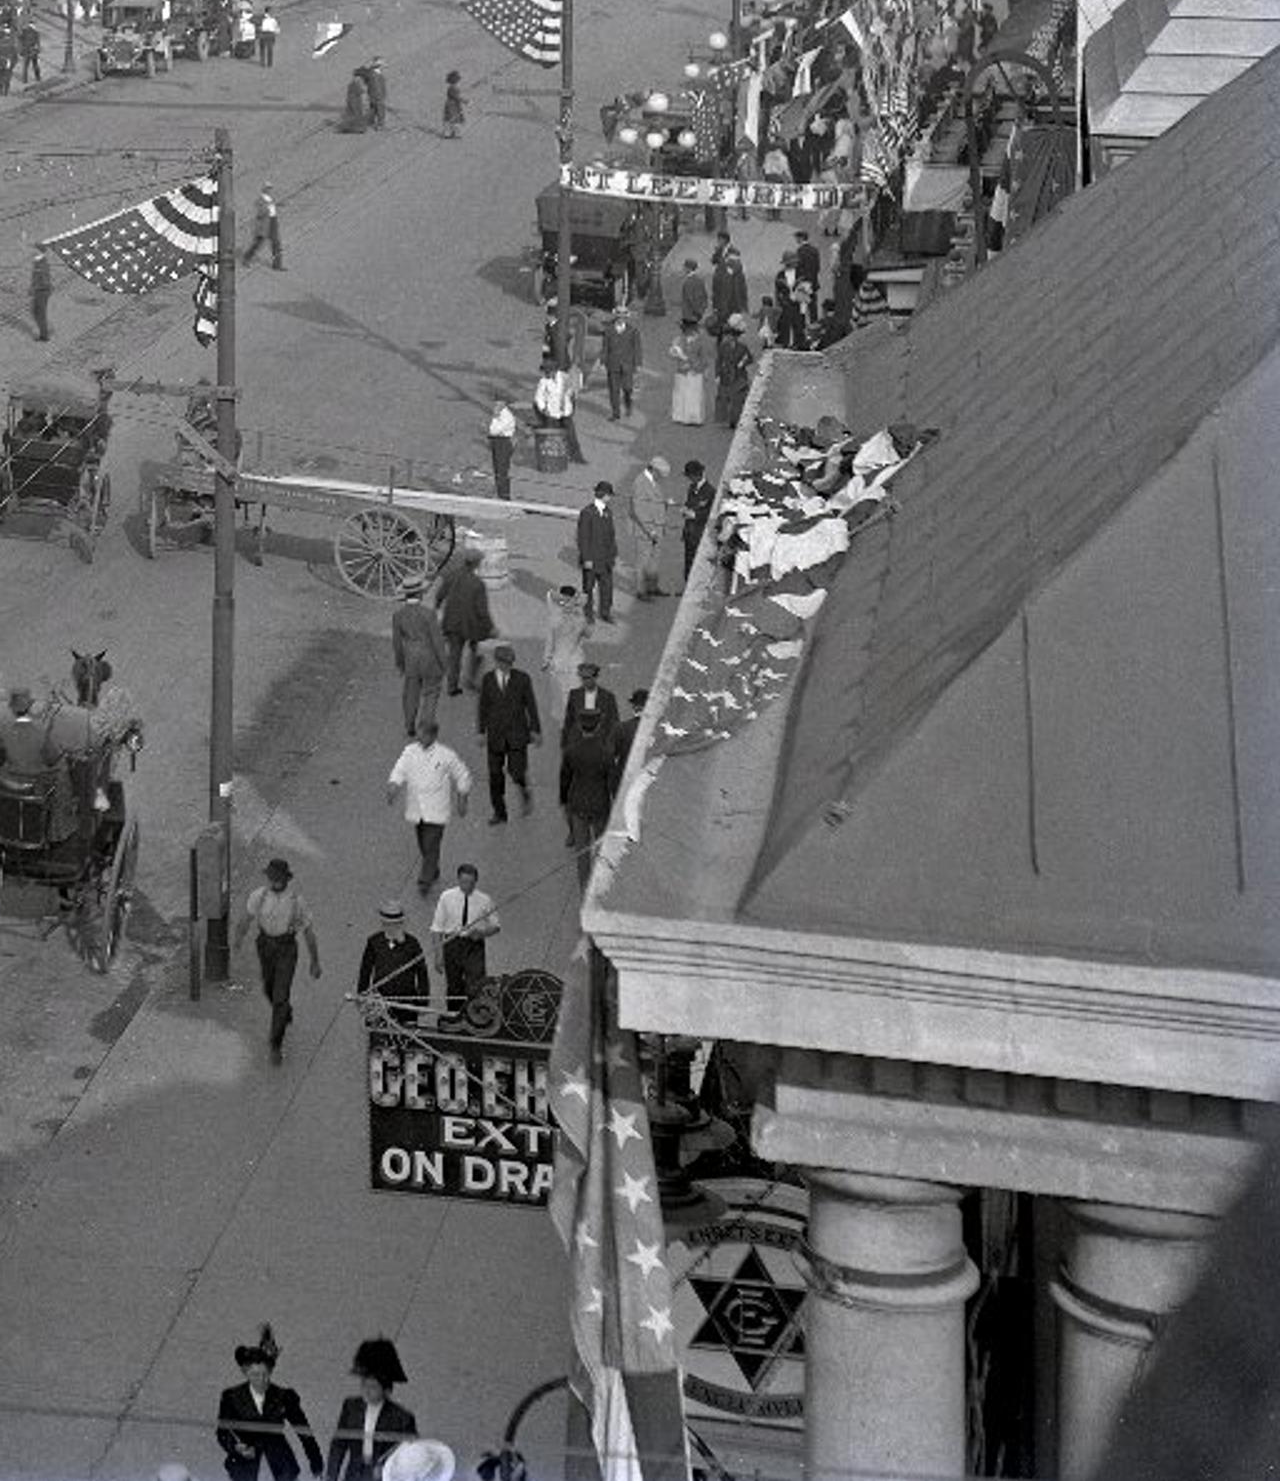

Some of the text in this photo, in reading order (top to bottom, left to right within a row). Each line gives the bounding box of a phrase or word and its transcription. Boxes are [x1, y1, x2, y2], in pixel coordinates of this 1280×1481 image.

[626, 174, 698, 199] LEE
[370, 1048, 480, 1117] GEO.
[381, 1146, 444, 1187] ON
